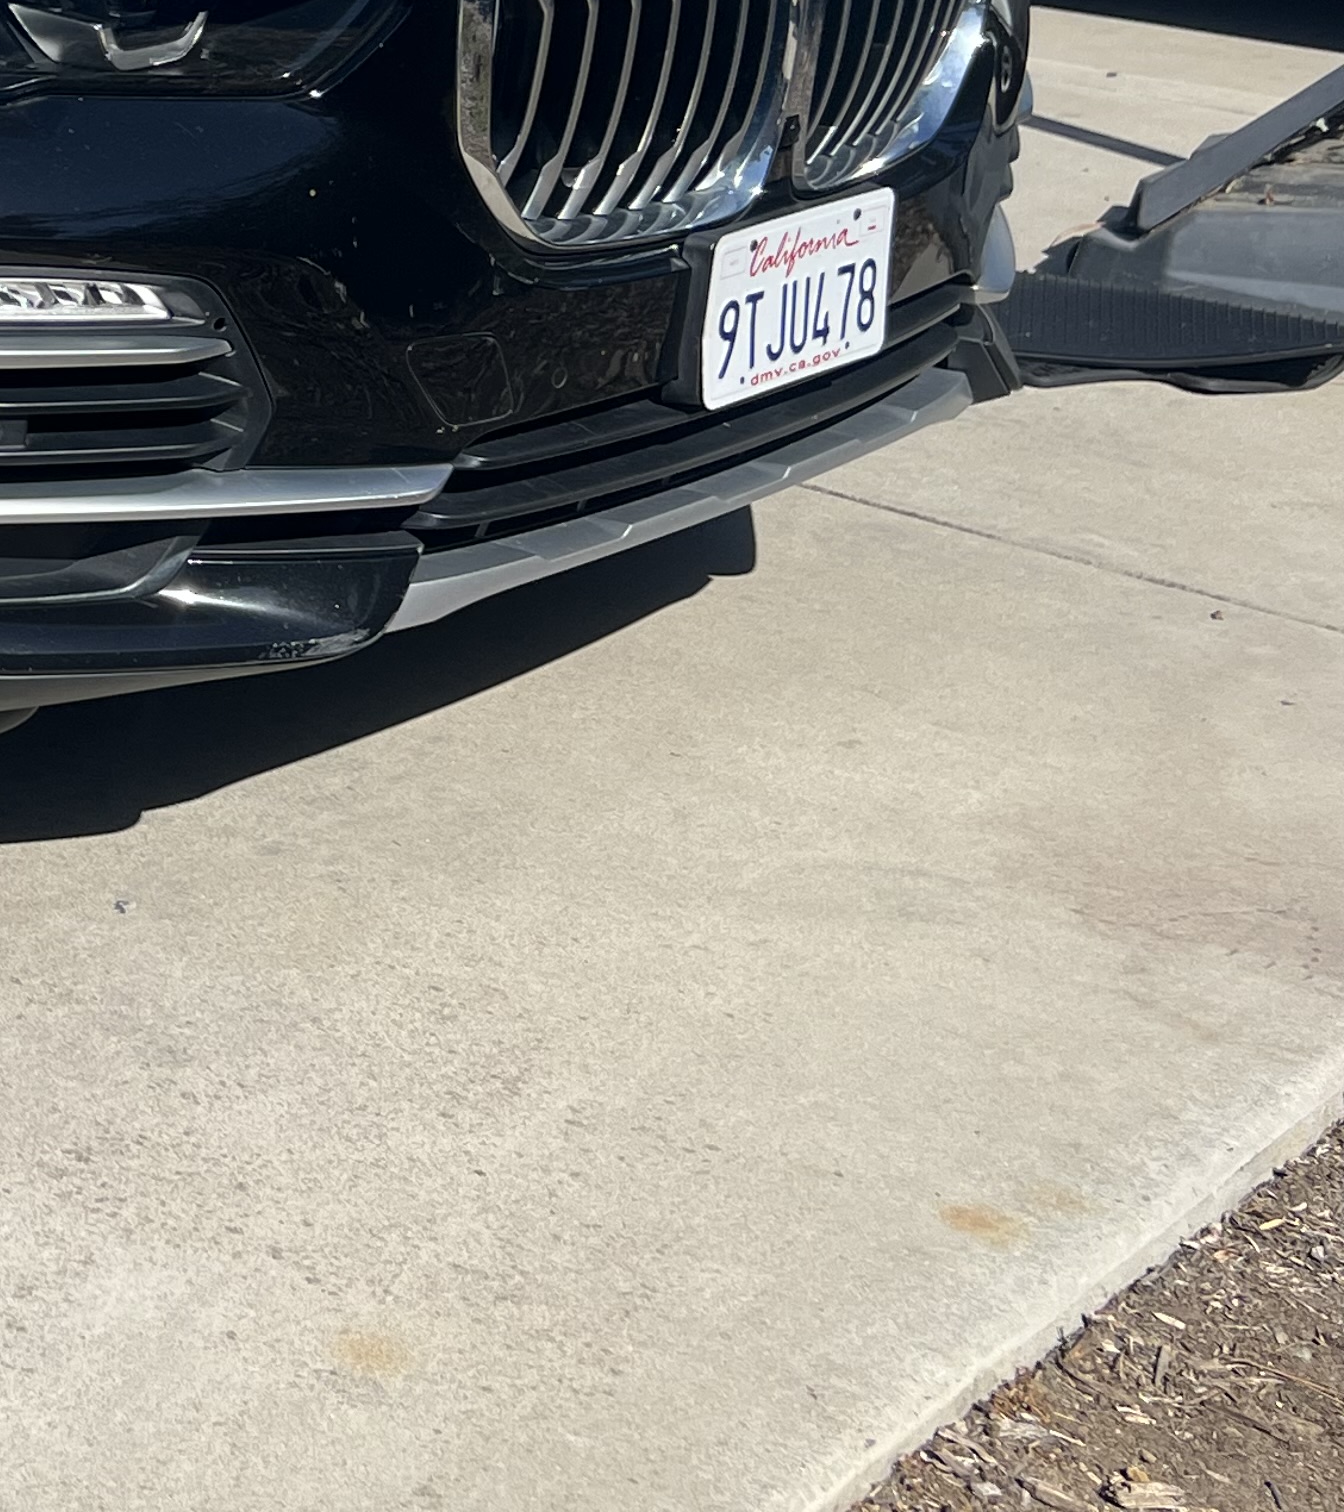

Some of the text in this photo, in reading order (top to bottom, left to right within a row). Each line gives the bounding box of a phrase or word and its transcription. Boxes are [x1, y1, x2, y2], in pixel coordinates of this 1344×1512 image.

[749, 227, 859, 277] California
[718, 258, 877, 379] 9TJU478
[750, 347, 841, 386] dmv.ca.gov
